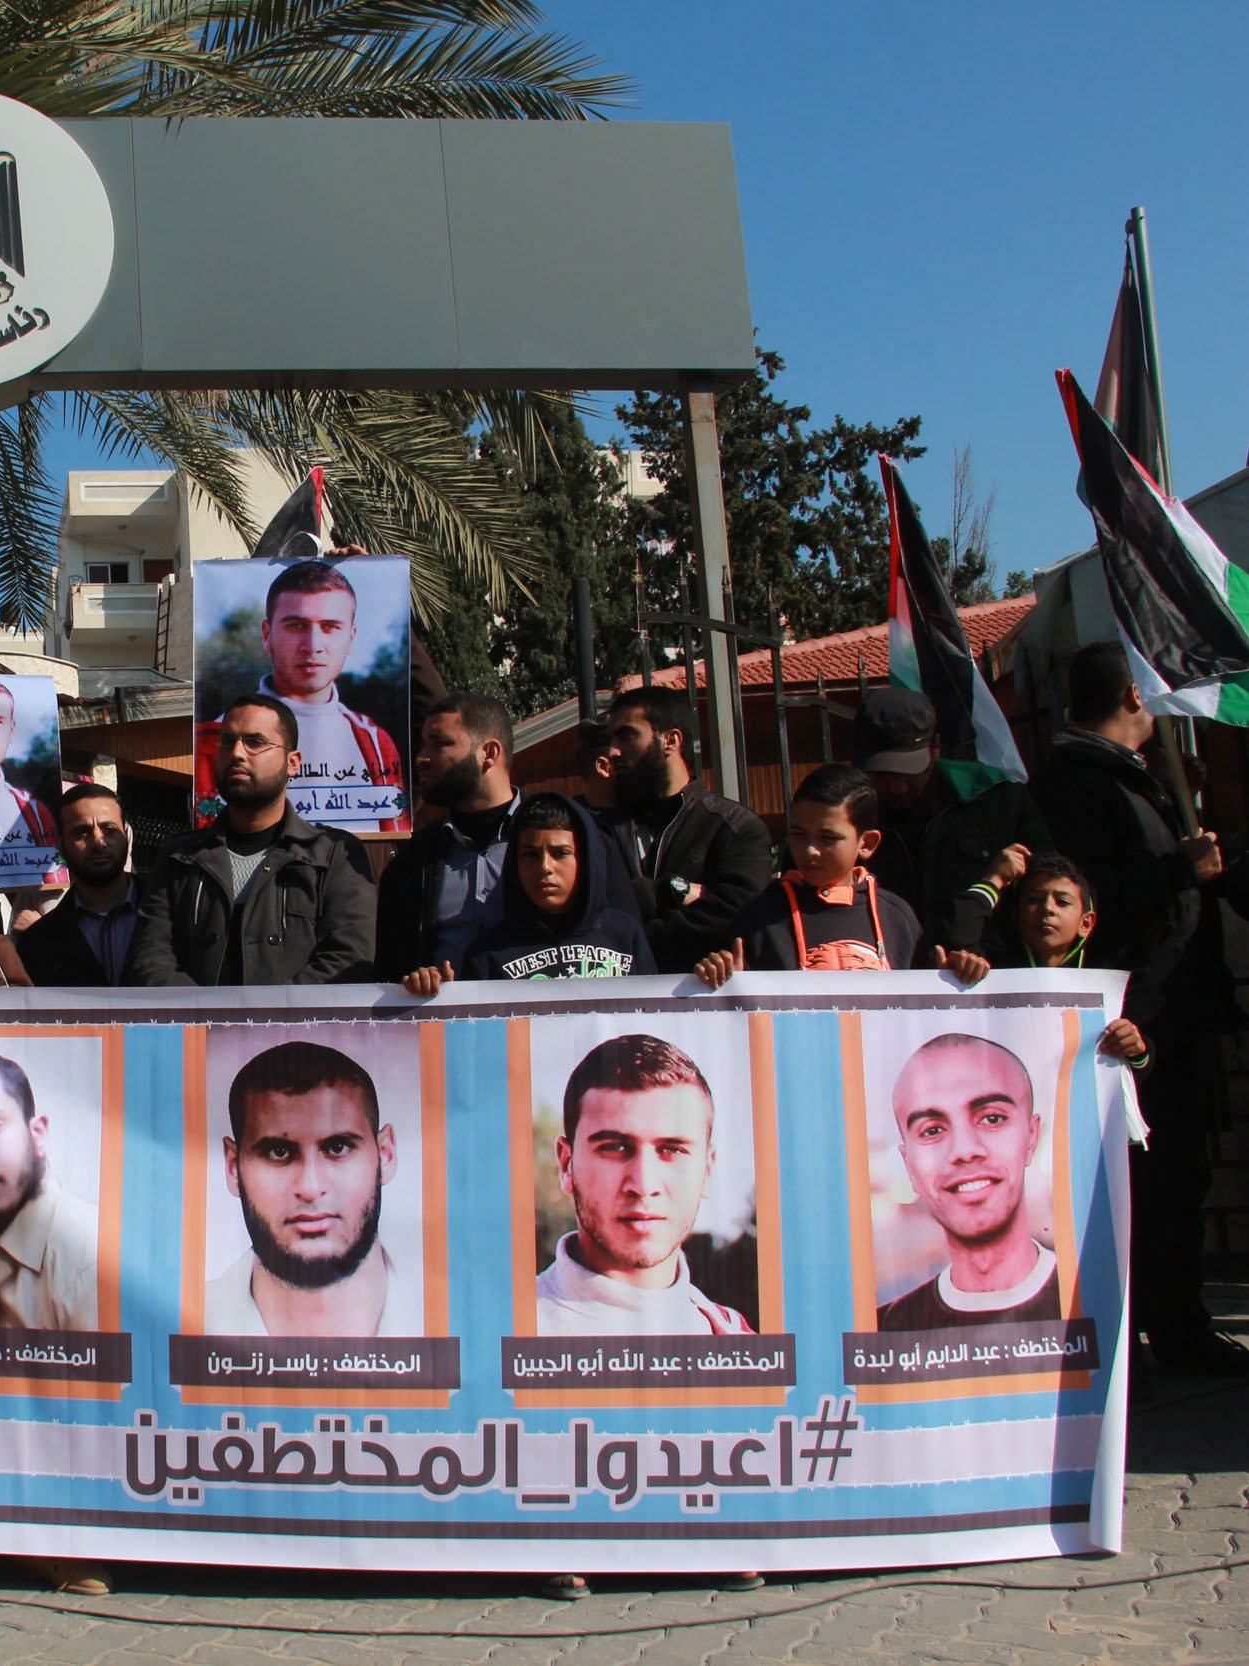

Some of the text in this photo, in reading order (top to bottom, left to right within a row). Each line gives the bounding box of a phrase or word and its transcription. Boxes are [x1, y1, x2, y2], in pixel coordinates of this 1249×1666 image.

[334, 765, 356, 781] عن
[295, 789, 392, 814] عبد الله أبو
[4, 830, 22, 843] عن
[0, 849, 21, 866] الله
[25, 854, 53, 868] عبد
[502, 947, 558, 980] WEST
[15, 1344, 97, 1367] المختطف
[898, 1342, 920, 1371] أبو
[925, 1343, 968, 1370] الدايم
[972, 1345, 1001, 1366] عبد
[1012, 1335, 1088, 1359] المختطف
[207, 1351, 263, 1375] زنون
[267, 1353, 319, 1377] ياسر
[333, 1353, 420, 1375] المختطف
[513, 1353, 572, 1377] الجبين
[577, 1347, 603, 1376] أبو
[608, 1348, 644, 1372] الله
[649, 1354, 682, 1376] عبد
[697, 1350, 785, 1372] المختطف
[854, 1348, 894, 1373] لبدة
